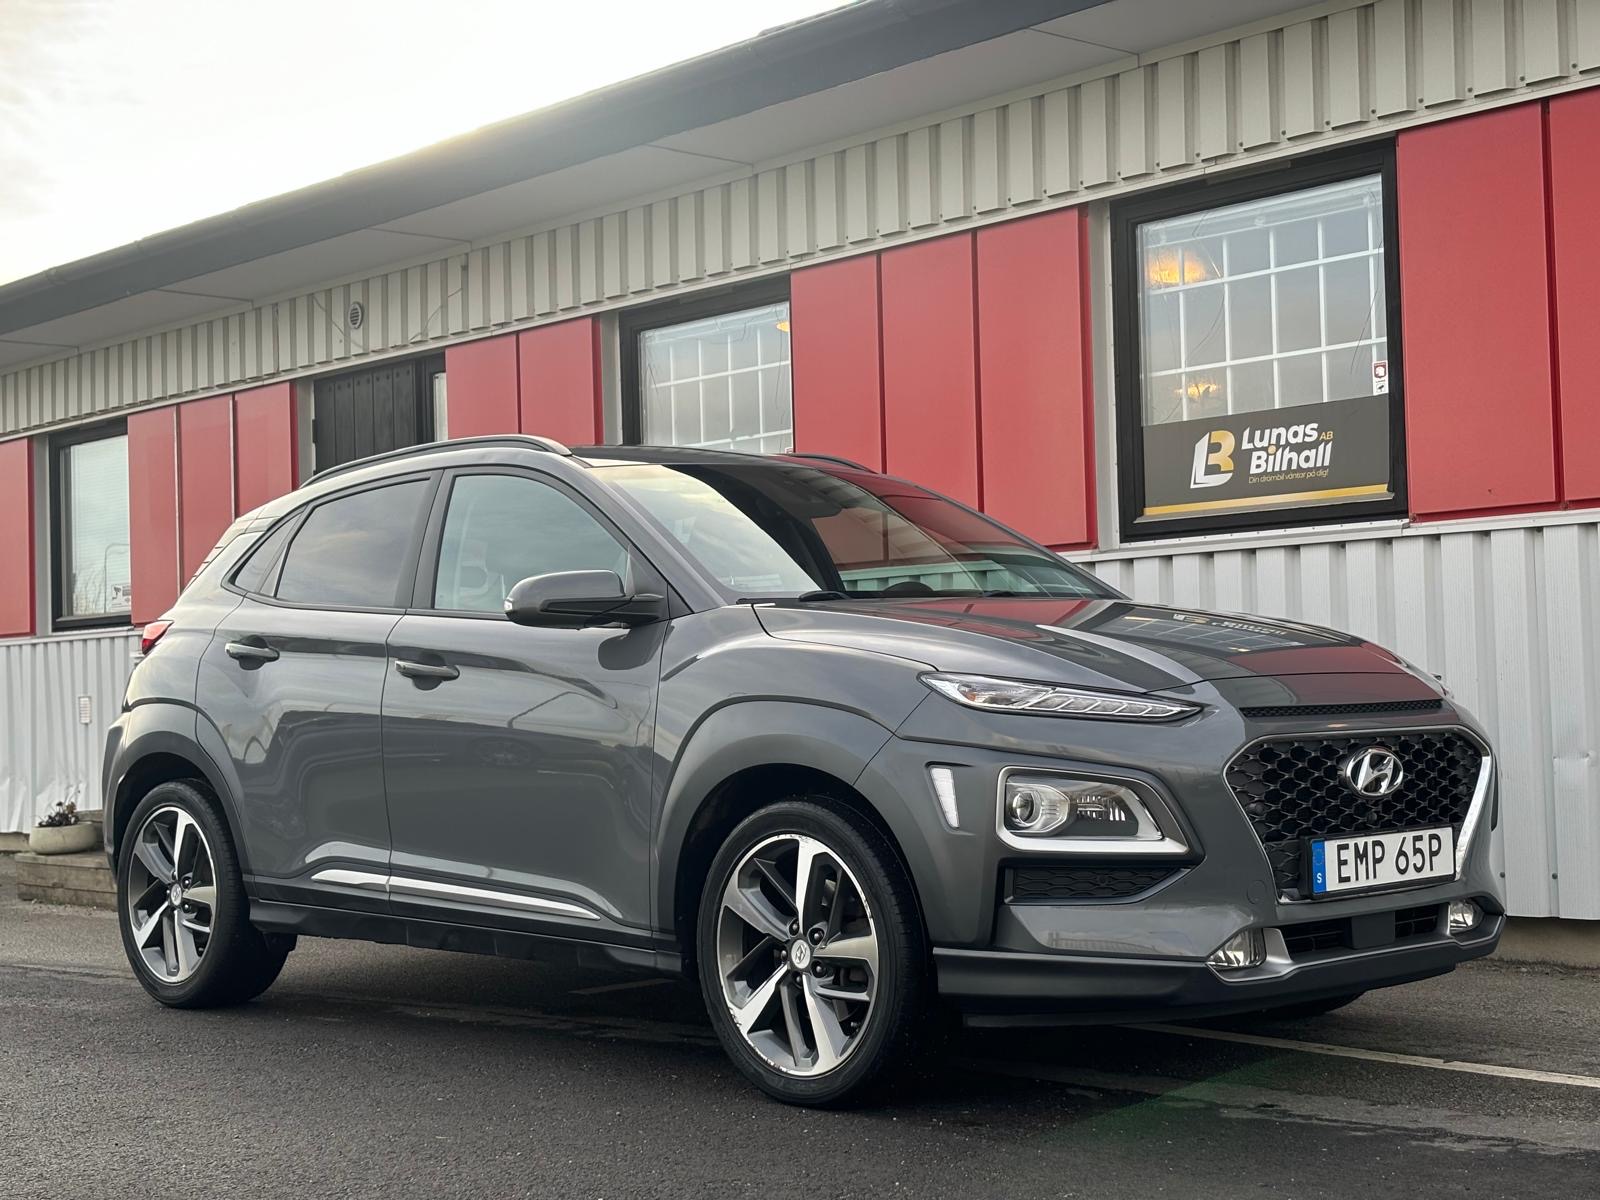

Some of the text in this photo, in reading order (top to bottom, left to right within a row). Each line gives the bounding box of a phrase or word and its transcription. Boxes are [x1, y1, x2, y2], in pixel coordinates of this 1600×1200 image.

[1241, 423, 1334, 450] Lunas AB
[1249, 441, 1333, 474] Bilhall
[1248, 476, 1260, 484] Din
[1336, 833, 1442, 883] EMP 65P
[1316, 872, 1322, 883] S
